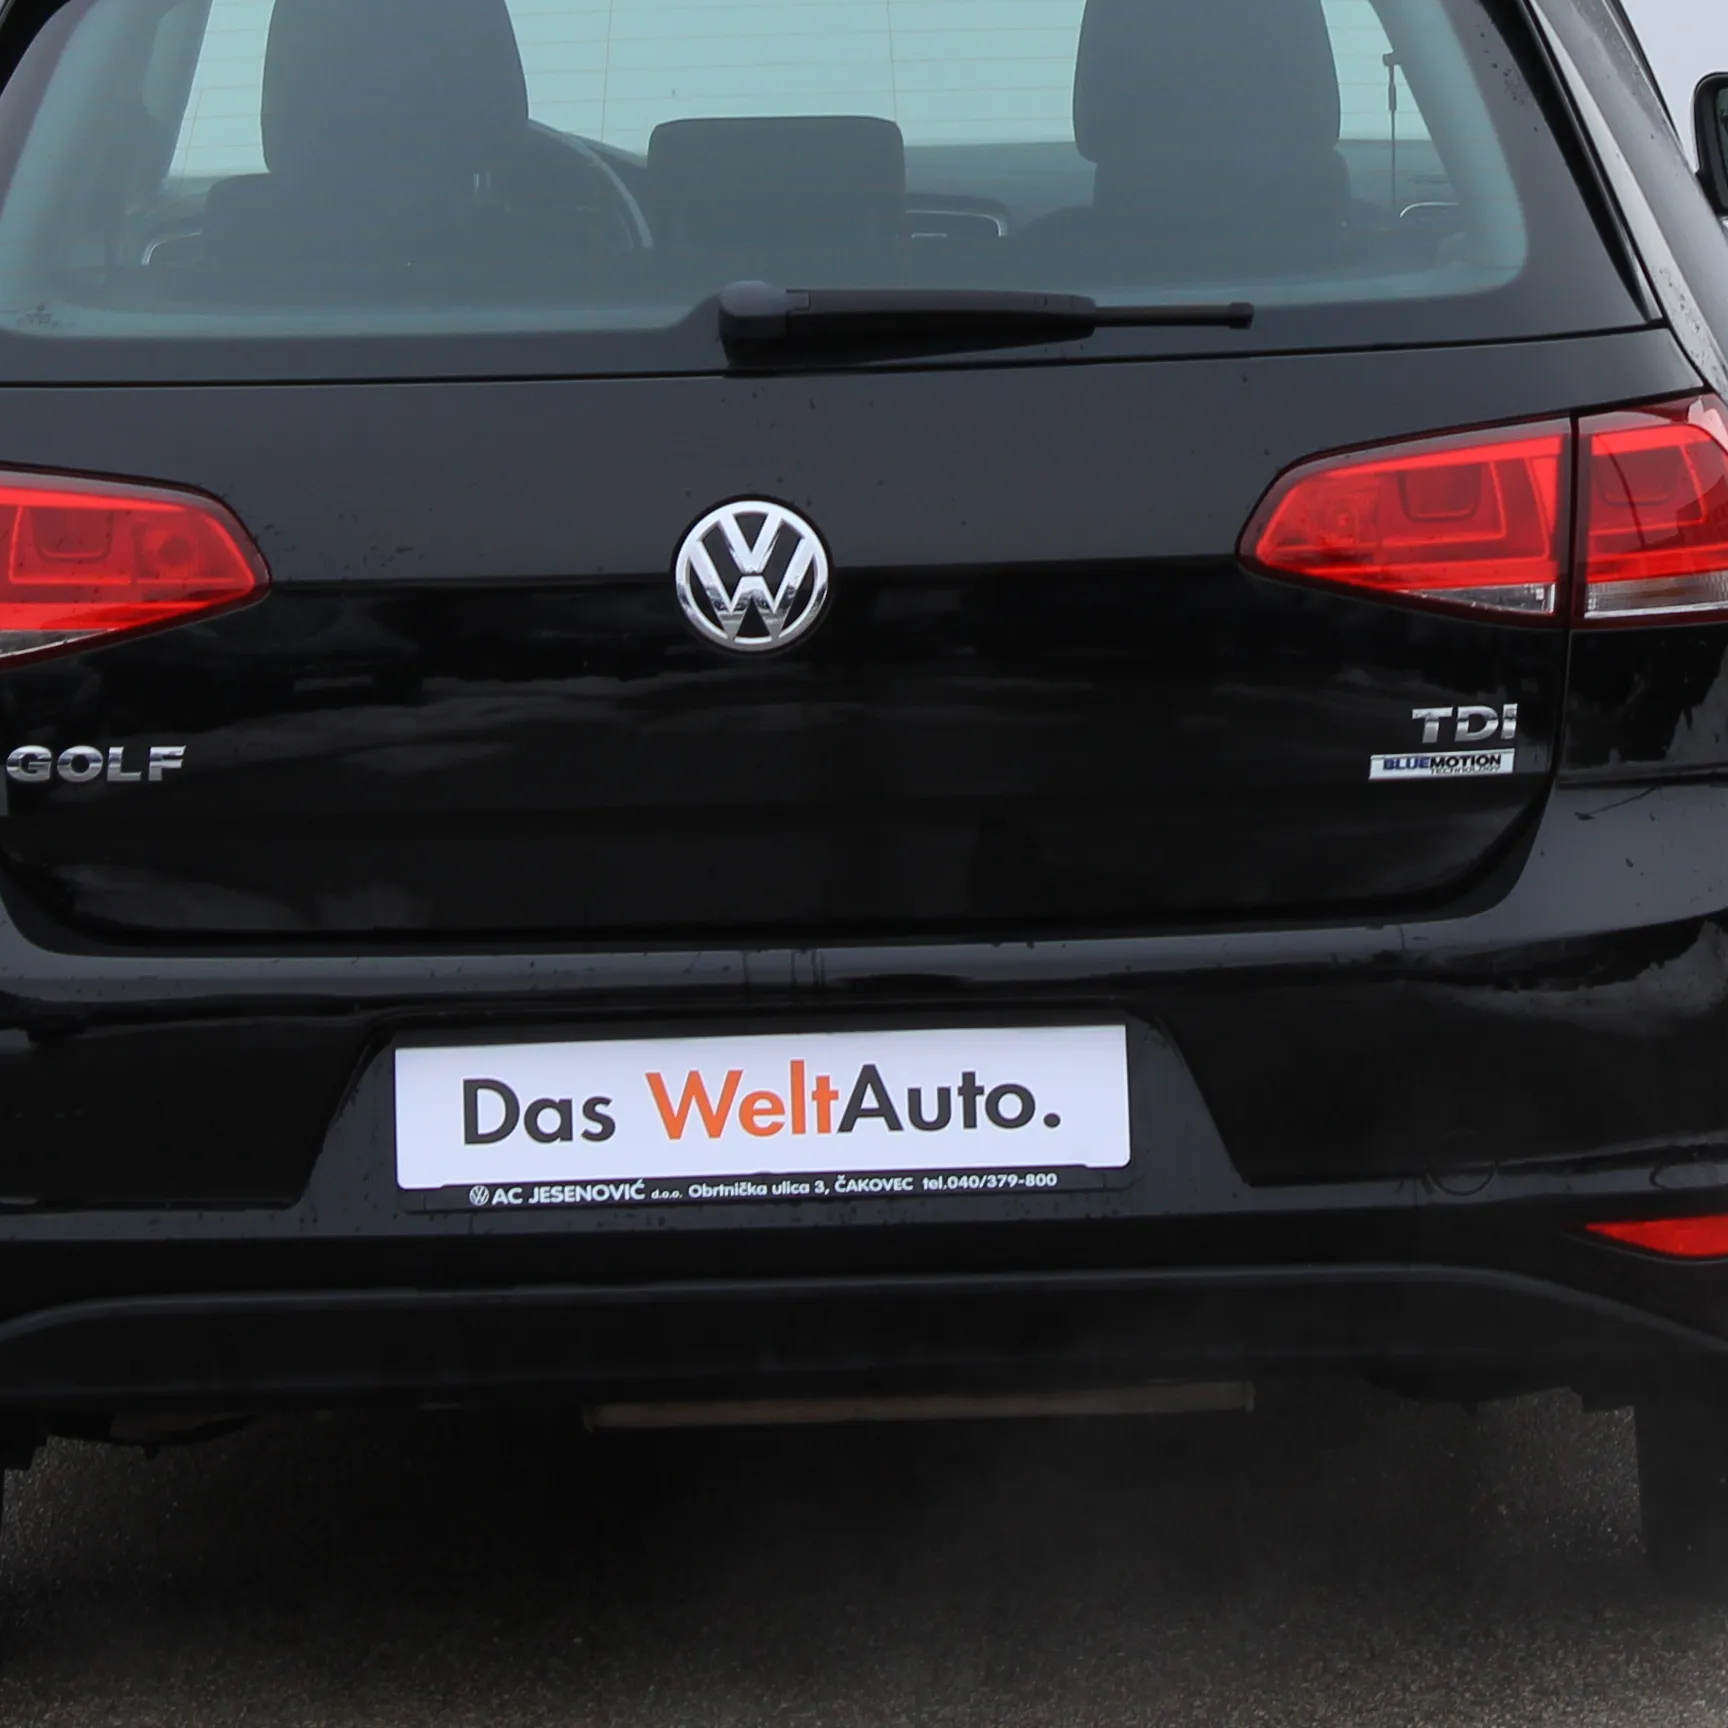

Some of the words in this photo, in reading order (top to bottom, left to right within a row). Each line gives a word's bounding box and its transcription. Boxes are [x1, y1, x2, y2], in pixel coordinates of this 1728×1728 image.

[1412, 703, 1518, 744] TDI
[5, 744, 187, 783] GOLF
[1383, 753, 1502, 770] BLUEMOTION
[463, 1078, 616, 1145] Das
[646, 1060, 1061, 1140] WeltAuto.
[491, 1187, 523, 1206] AC
[528, 1179, 646, 1204] JESENOVIĆ
[651, 1188, 683, 1199] d.o.o.
[689, 1180, 768, 1199] Obrtnička
[772, 1178, 810, 1196] ulica
[815, 1179, 830, 1196] 3,
[834, 1174, 914, 1193] ČAKOVEC
